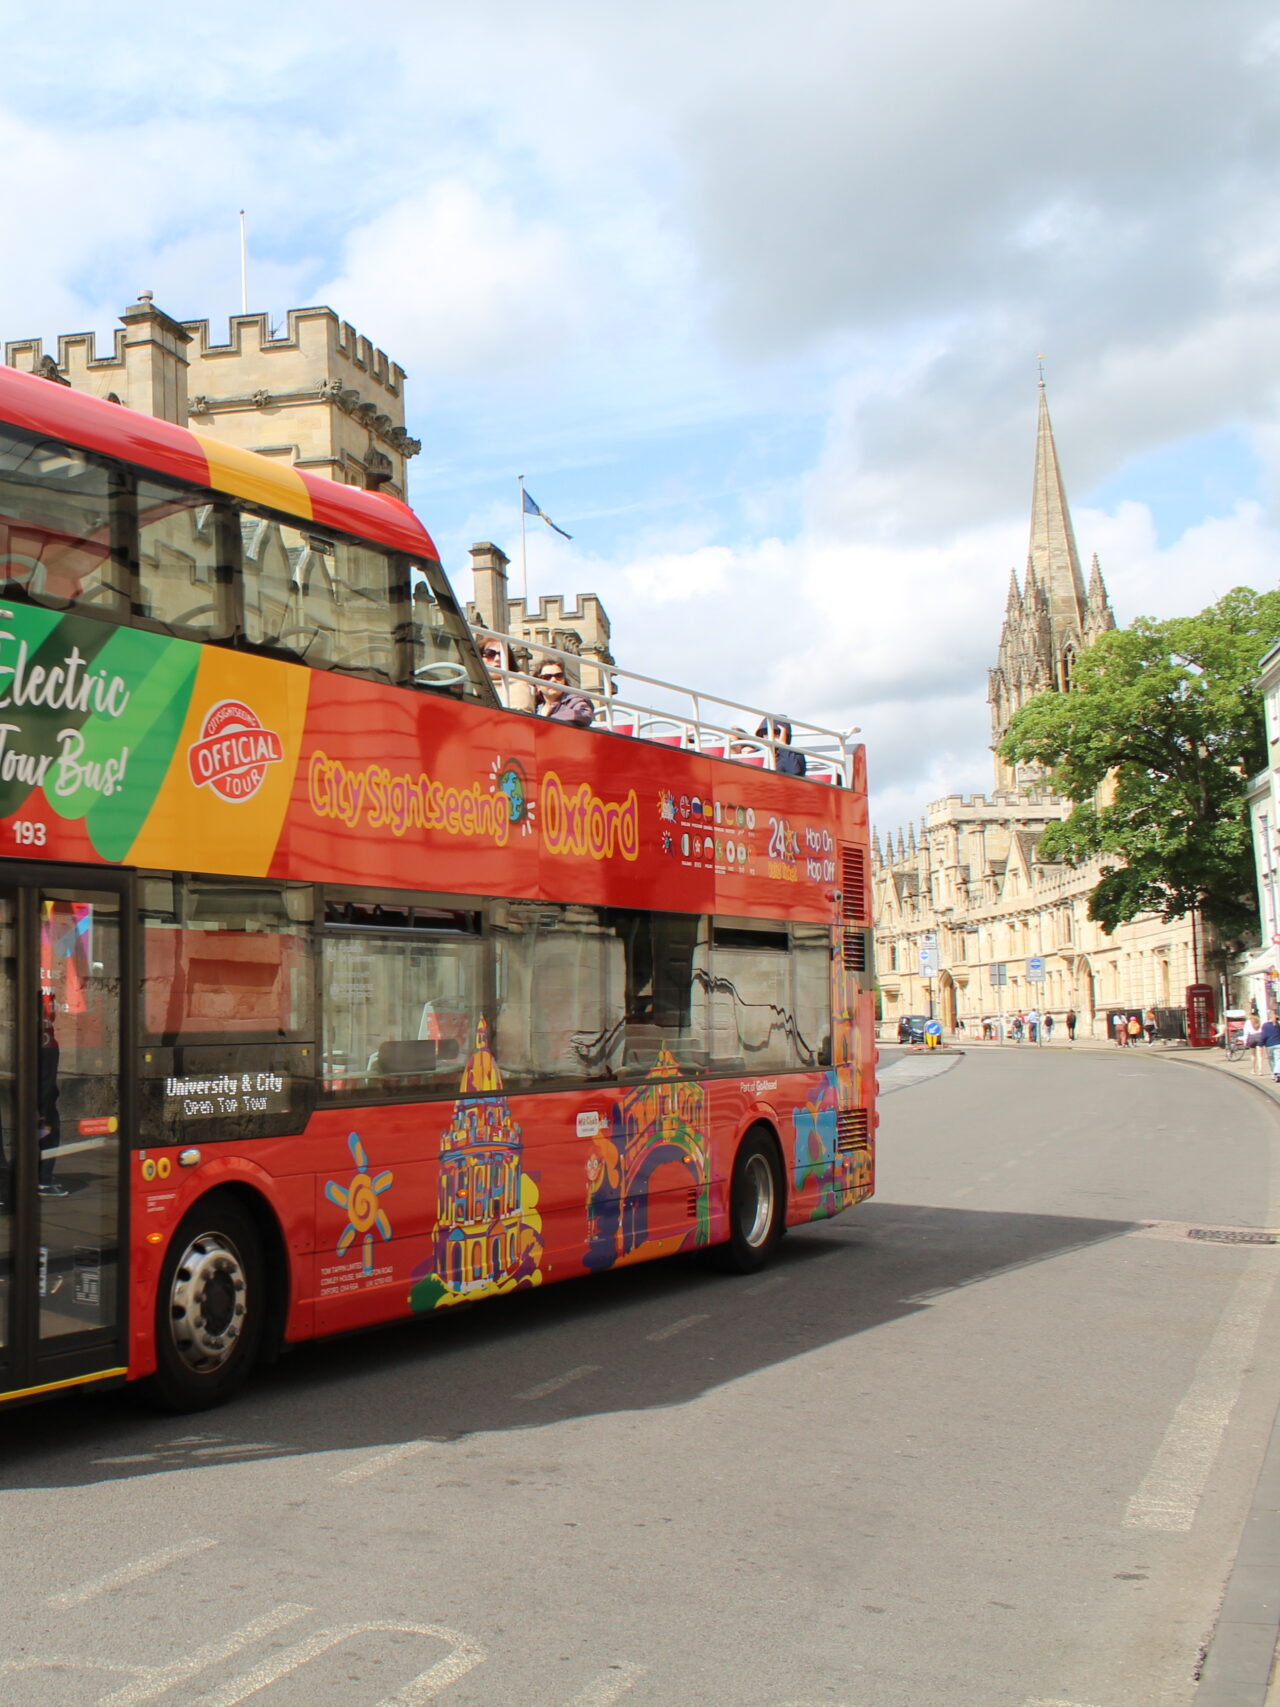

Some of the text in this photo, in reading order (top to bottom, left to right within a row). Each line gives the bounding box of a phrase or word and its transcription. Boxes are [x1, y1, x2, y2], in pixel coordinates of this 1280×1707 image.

[55, 728, 129, 797] Bus!
[198, 735, 278, 777] OFFICIAL
[225, 769, 261, 795] TOUR
[542, 771, 639, 861] Oxford
[12, 820, 47, 847] 193
[769, 817, 786, 859] 24
[805, 827, 833, 852] Hop On
[806, 856, 822, 882] Hop
[823, 859, 836, 881] Off
[166, 1073, 282, 1096] University & City
[183, 1096, 267, 1115] Open Top Tour
